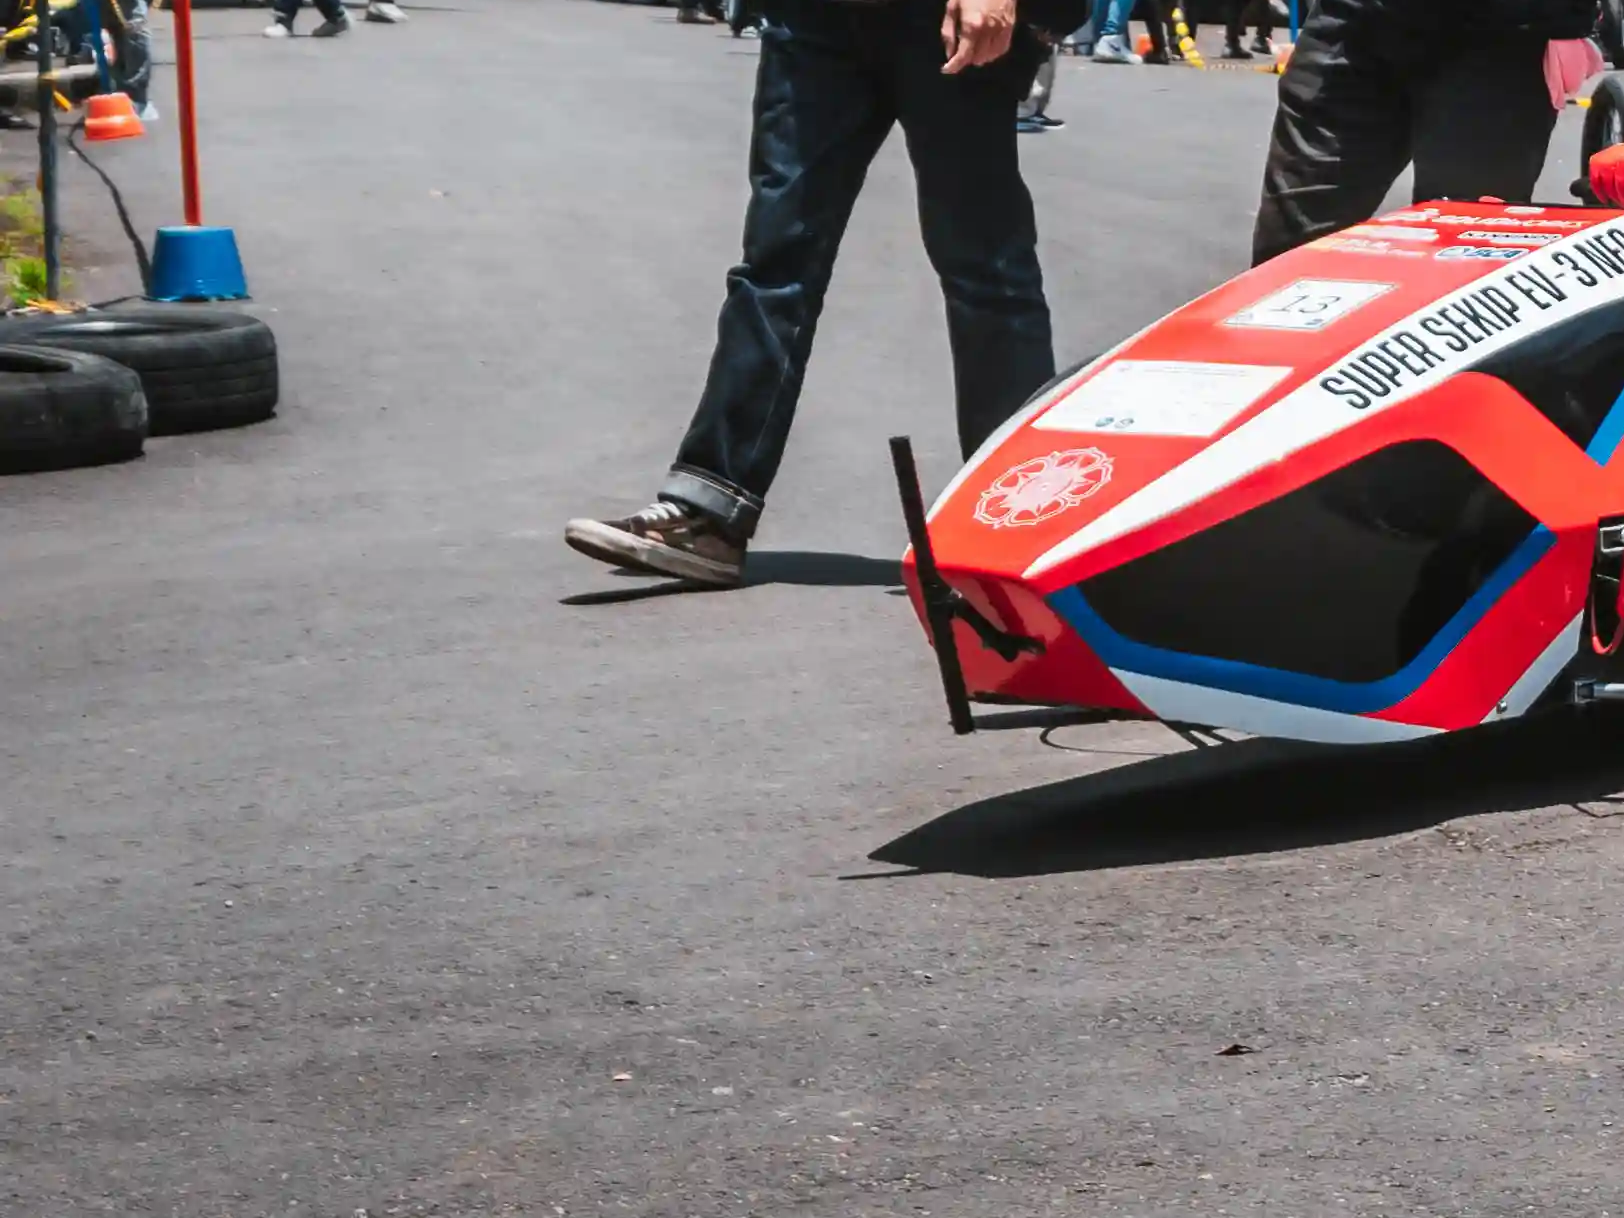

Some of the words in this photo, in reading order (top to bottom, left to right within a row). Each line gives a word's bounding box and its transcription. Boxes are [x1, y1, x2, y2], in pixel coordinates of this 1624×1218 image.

[1268, 294, 1342, 314] 13
[1319, 330, 1446, 410] SUPER
[1418, 284, 1522, 353] SEKIP
[1504, 249, 1599, 311] EV-3
